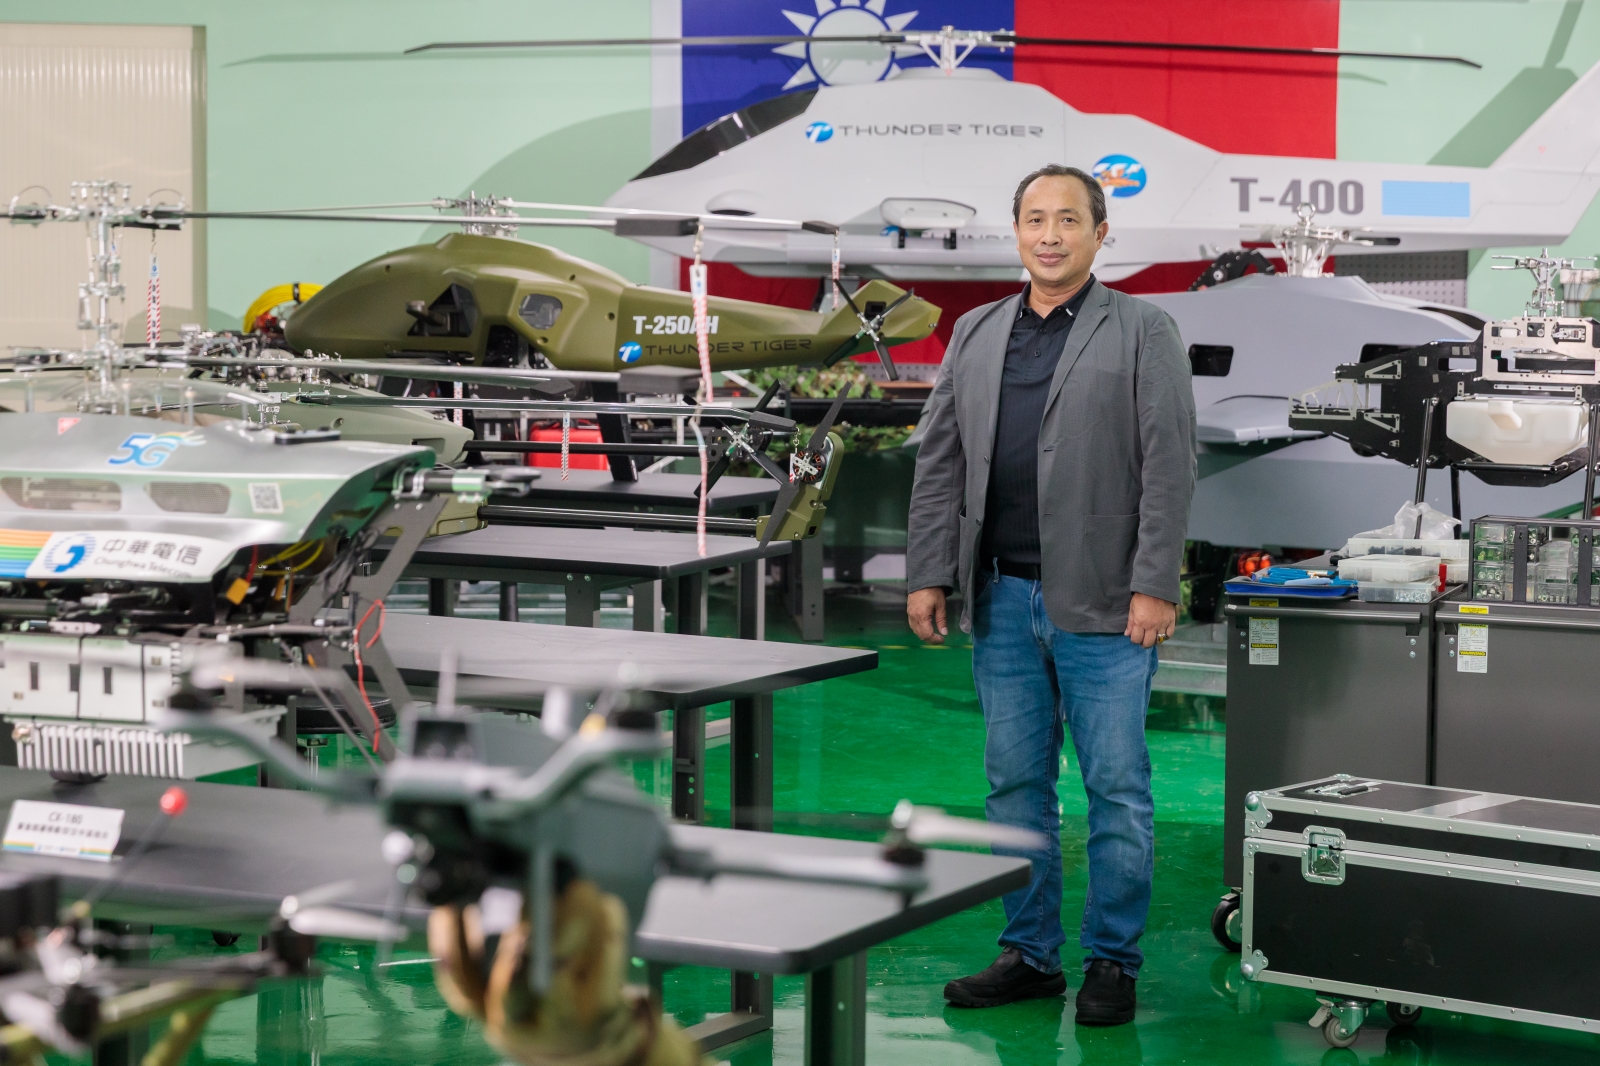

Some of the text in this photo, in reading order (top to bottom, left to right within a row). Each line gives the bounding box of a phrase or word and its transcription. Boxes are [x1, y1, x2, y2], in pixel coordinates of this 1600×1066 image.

[838, 124, 1044, 137] THUNDER TIGER
[1230, 177, 1364, 215] T-400
[750, 338, 812, 352] TIGER
[108, 433, 179, 469] 5G
[102, 538, 202, 566] 中華電信
